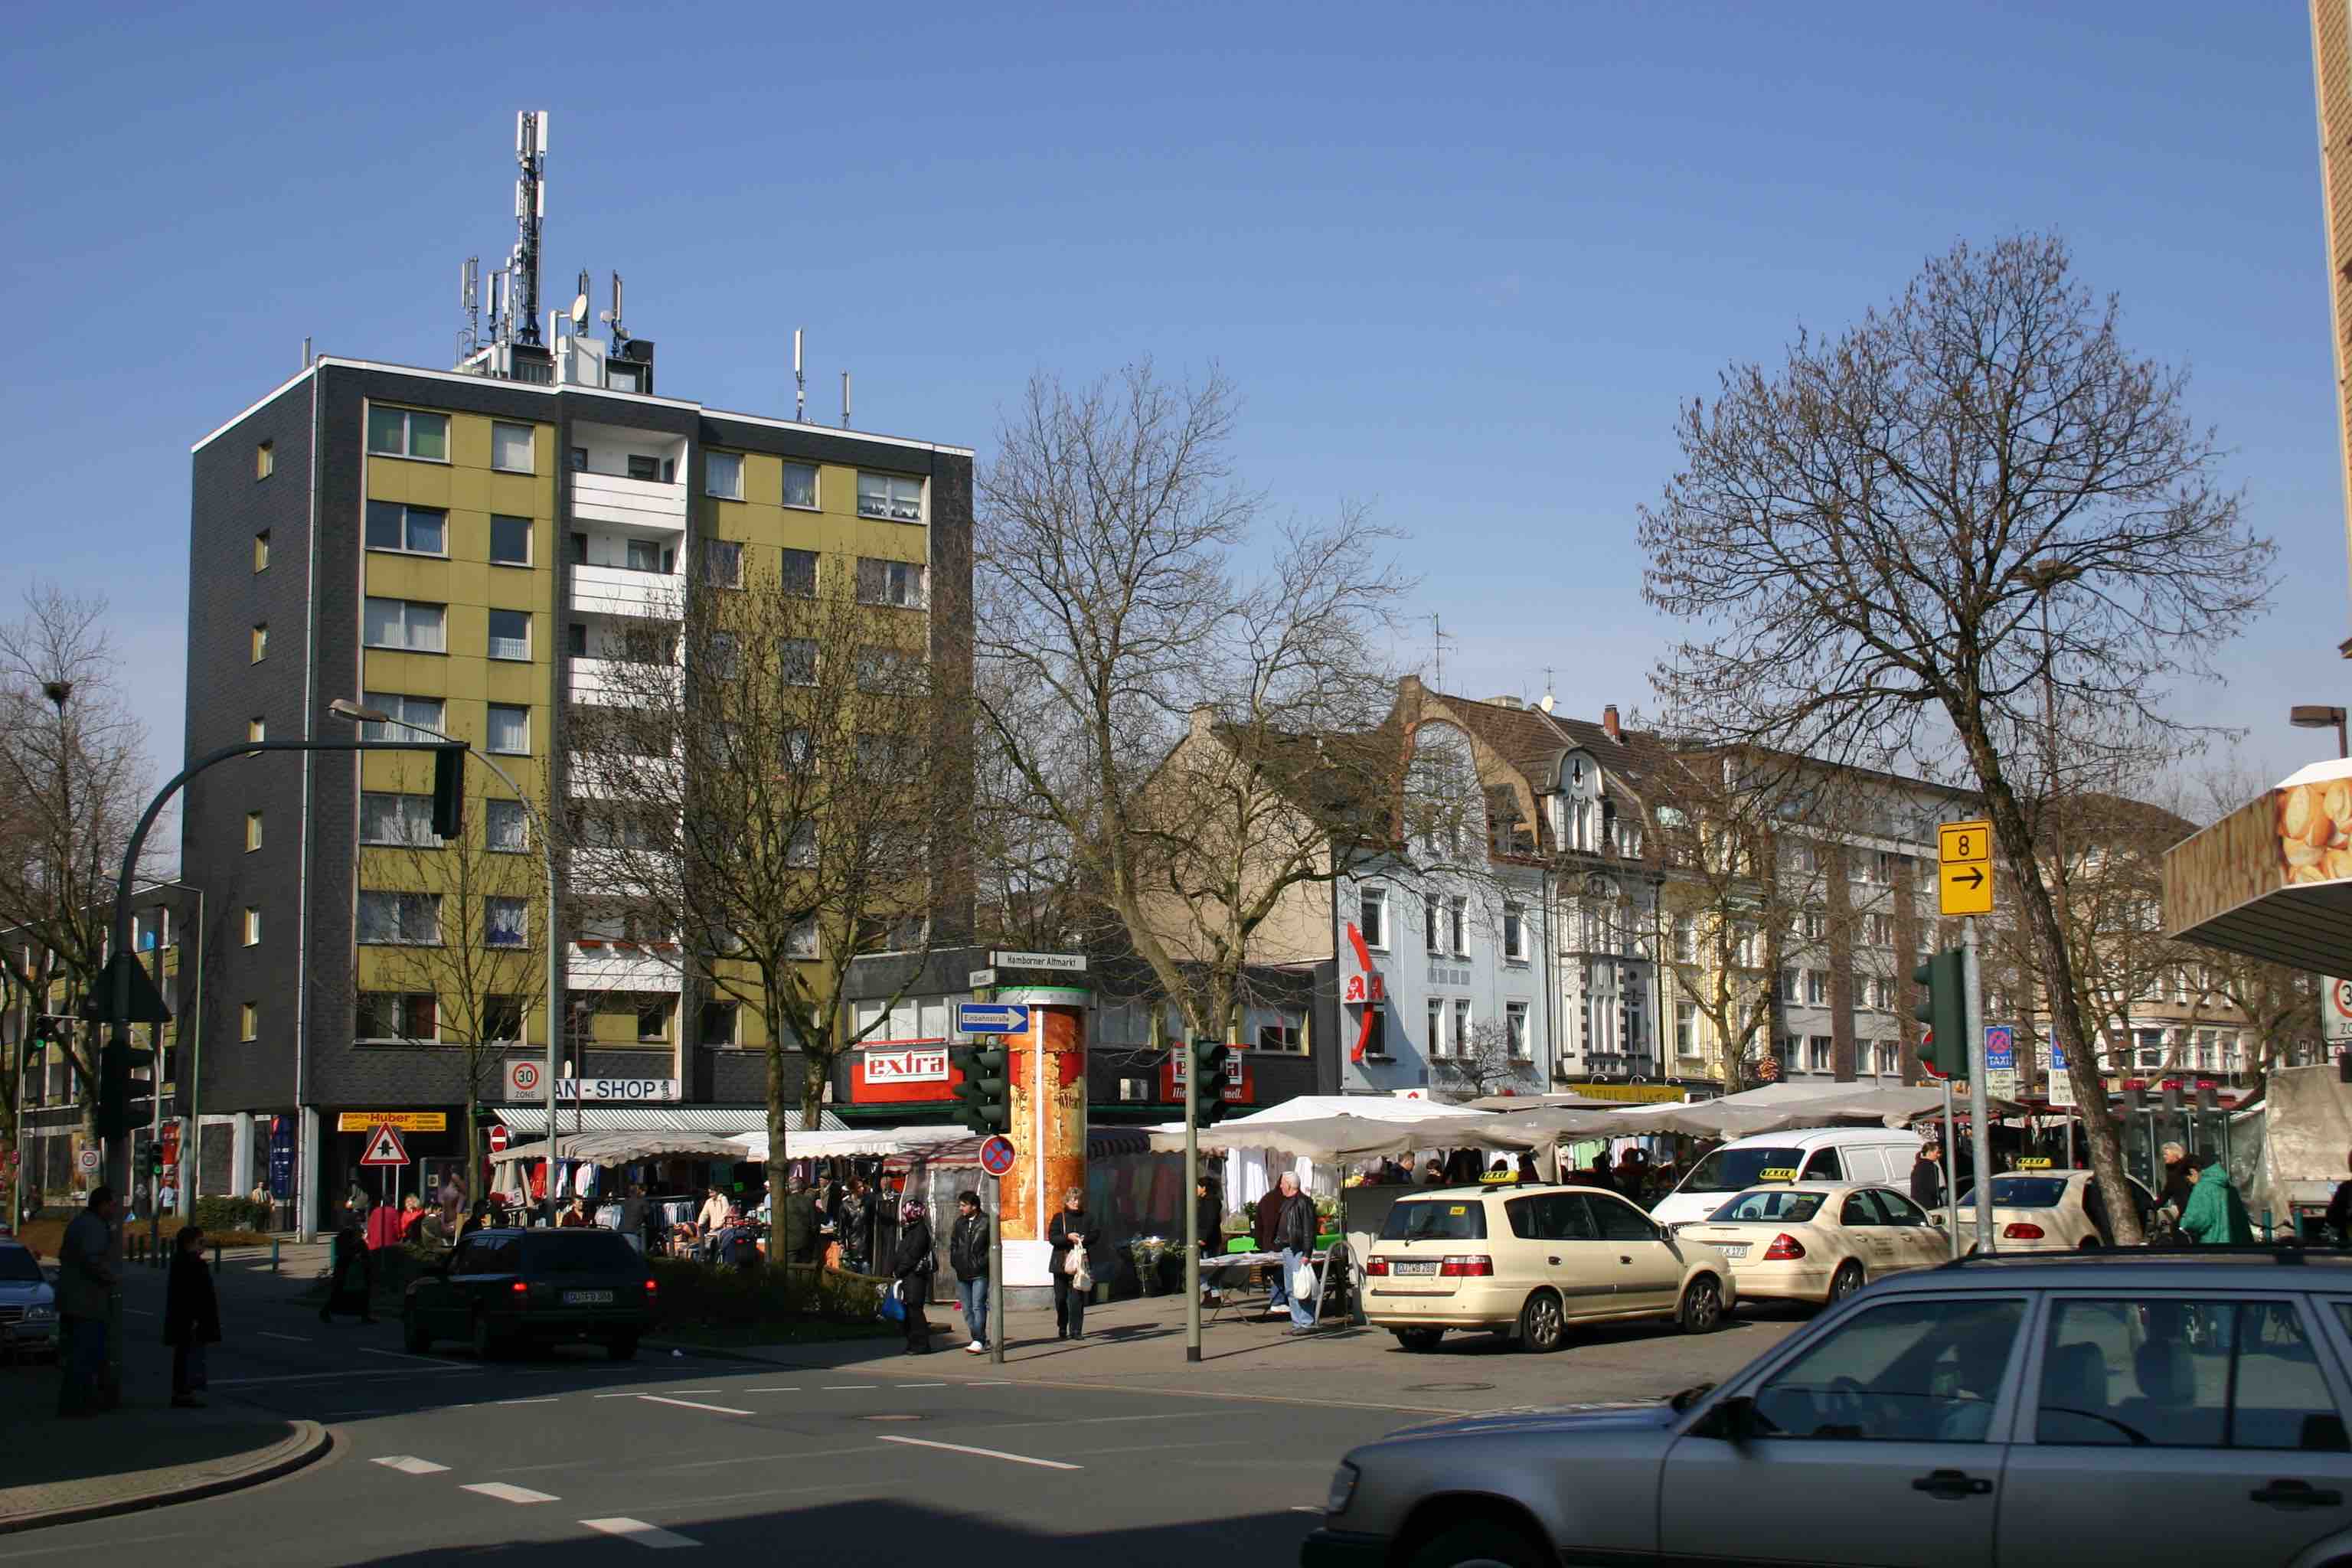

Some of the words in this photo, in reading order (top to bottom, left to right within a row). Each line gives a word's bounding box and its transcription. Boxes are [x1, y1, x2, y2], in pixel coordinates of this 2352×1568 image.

[1958, 835, 1969, 856] 8
[1008, 955, 1044, 965] Hamborner
[1047, 956, 1076, 967] Altmarkt
[2341, 985, 2352, 1006] 3
[964, 1014, 1010, 1022] Einbahnstraße
[2340, 1022, 2352, 1035] ZO
[870, 1052, 944, 1076] extra
[1988, 1056, 2010, 1066] TAXI
[2054, 1056, 2066, 1066] TA
[518, 1070, 534, 1083] 30
[554, 1080, 577, 1098] AN
[596, 1080, 656, 1098] SHOP
[370, 1112, 411, 1122] Huber
